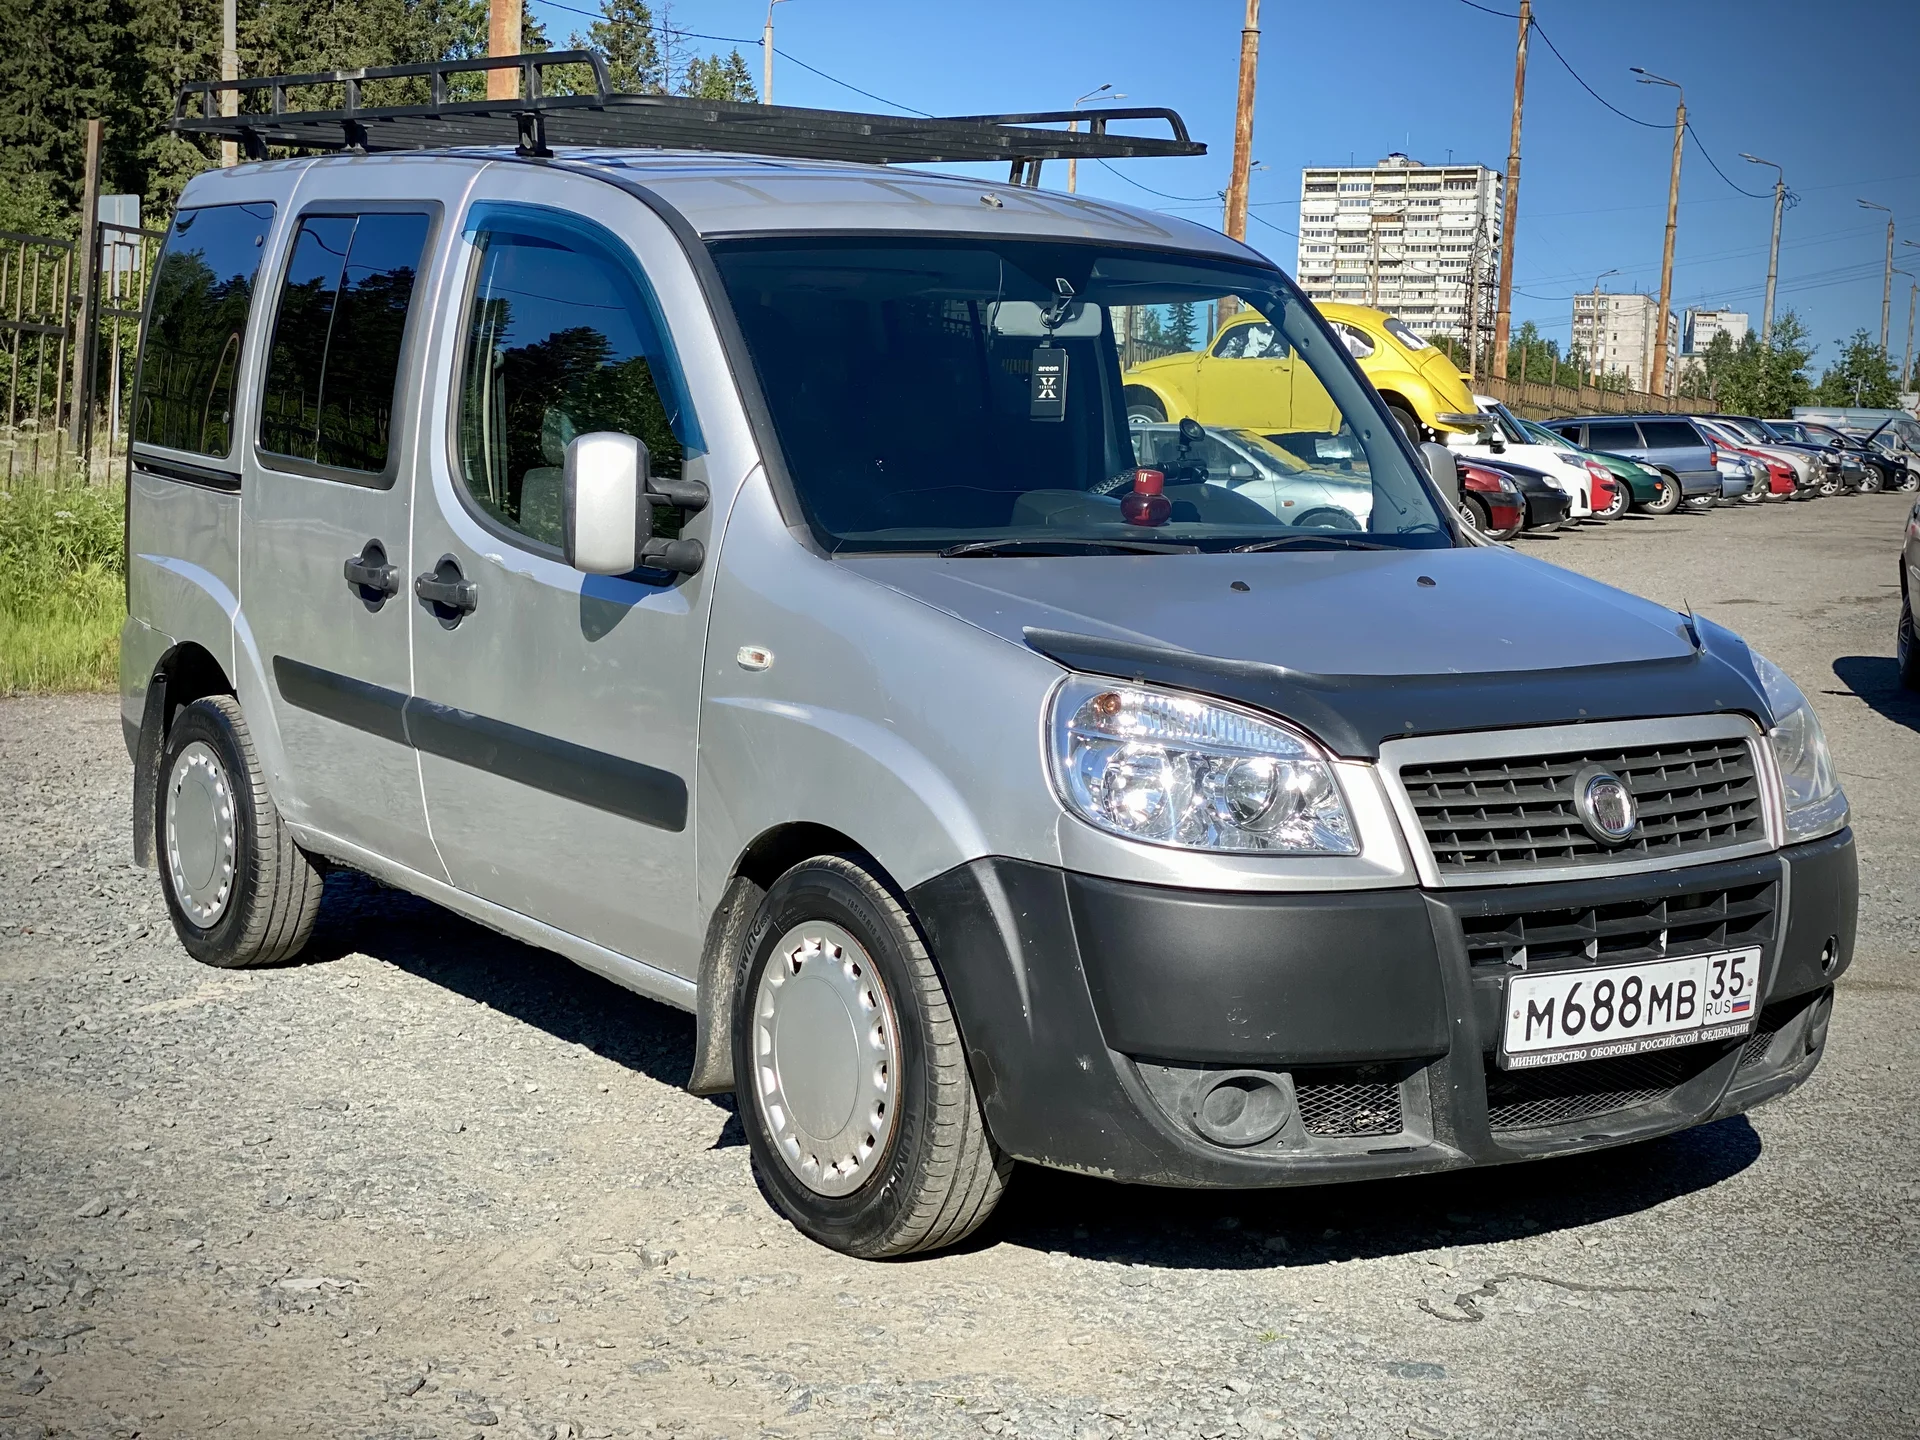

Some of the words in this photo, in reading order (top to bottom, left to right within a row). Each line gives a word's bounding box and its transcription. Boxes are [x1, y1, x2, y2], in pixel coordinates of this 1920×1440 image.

[1525, 975, 1697, 1041] М688МВ
[1710, 957, 1746, 1000] 35
[1705, 1000, 1731, 1017] RUS
[1510, 1049, 1587, 1068] МИНИСТЕРСТВО
[1590, 1042, 1637, 1058] ОБОРОНЫ
[1639, 1031, 1699, 1051] РОССИЙСКОЙ
[1701, 1023, 1750, 1041] ФЕДЕРАЦИИ
